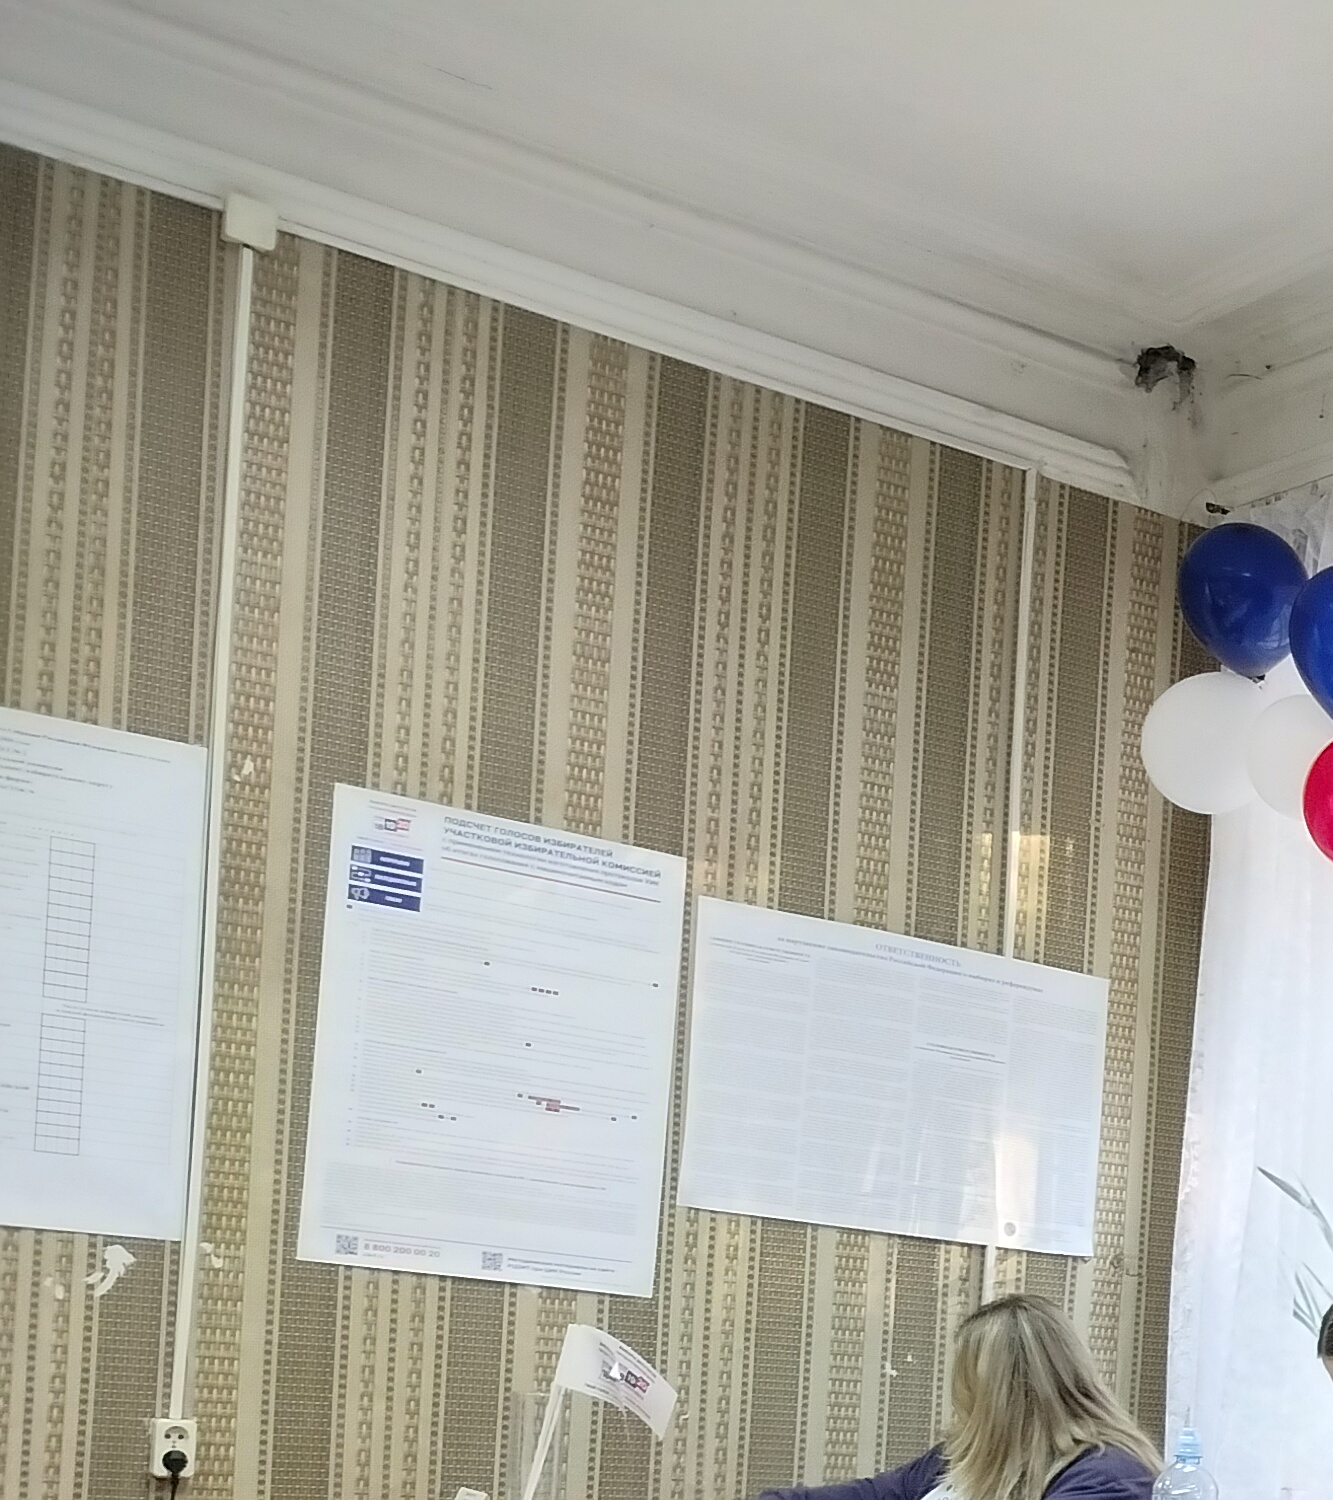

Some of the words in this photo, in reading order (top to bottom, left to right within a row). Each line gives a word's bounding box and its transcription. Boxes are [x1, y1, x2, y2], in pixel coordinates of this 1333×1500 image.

[443, 827, 512, 848] УЧАСТКОВОЙ
[514, 842, 600, 865] ИЗБИРАТЕЛЬНОЙ
[602, 861, 661, 878] КОМИССИЕЙ
[444, 816, 492, 832] ПОДСЧЕТ
[494, 827, 542, 842] ГОЛОСОВ
[543, 838, 613, 858] ИЗБИРАТЕЛЕЙ
[875, 942, 962, 967] ОТВЕТСТВЕННОСТЬ
[393, 1246, 412, 1255] 200
[428, 1250, 441, 1258] 20
